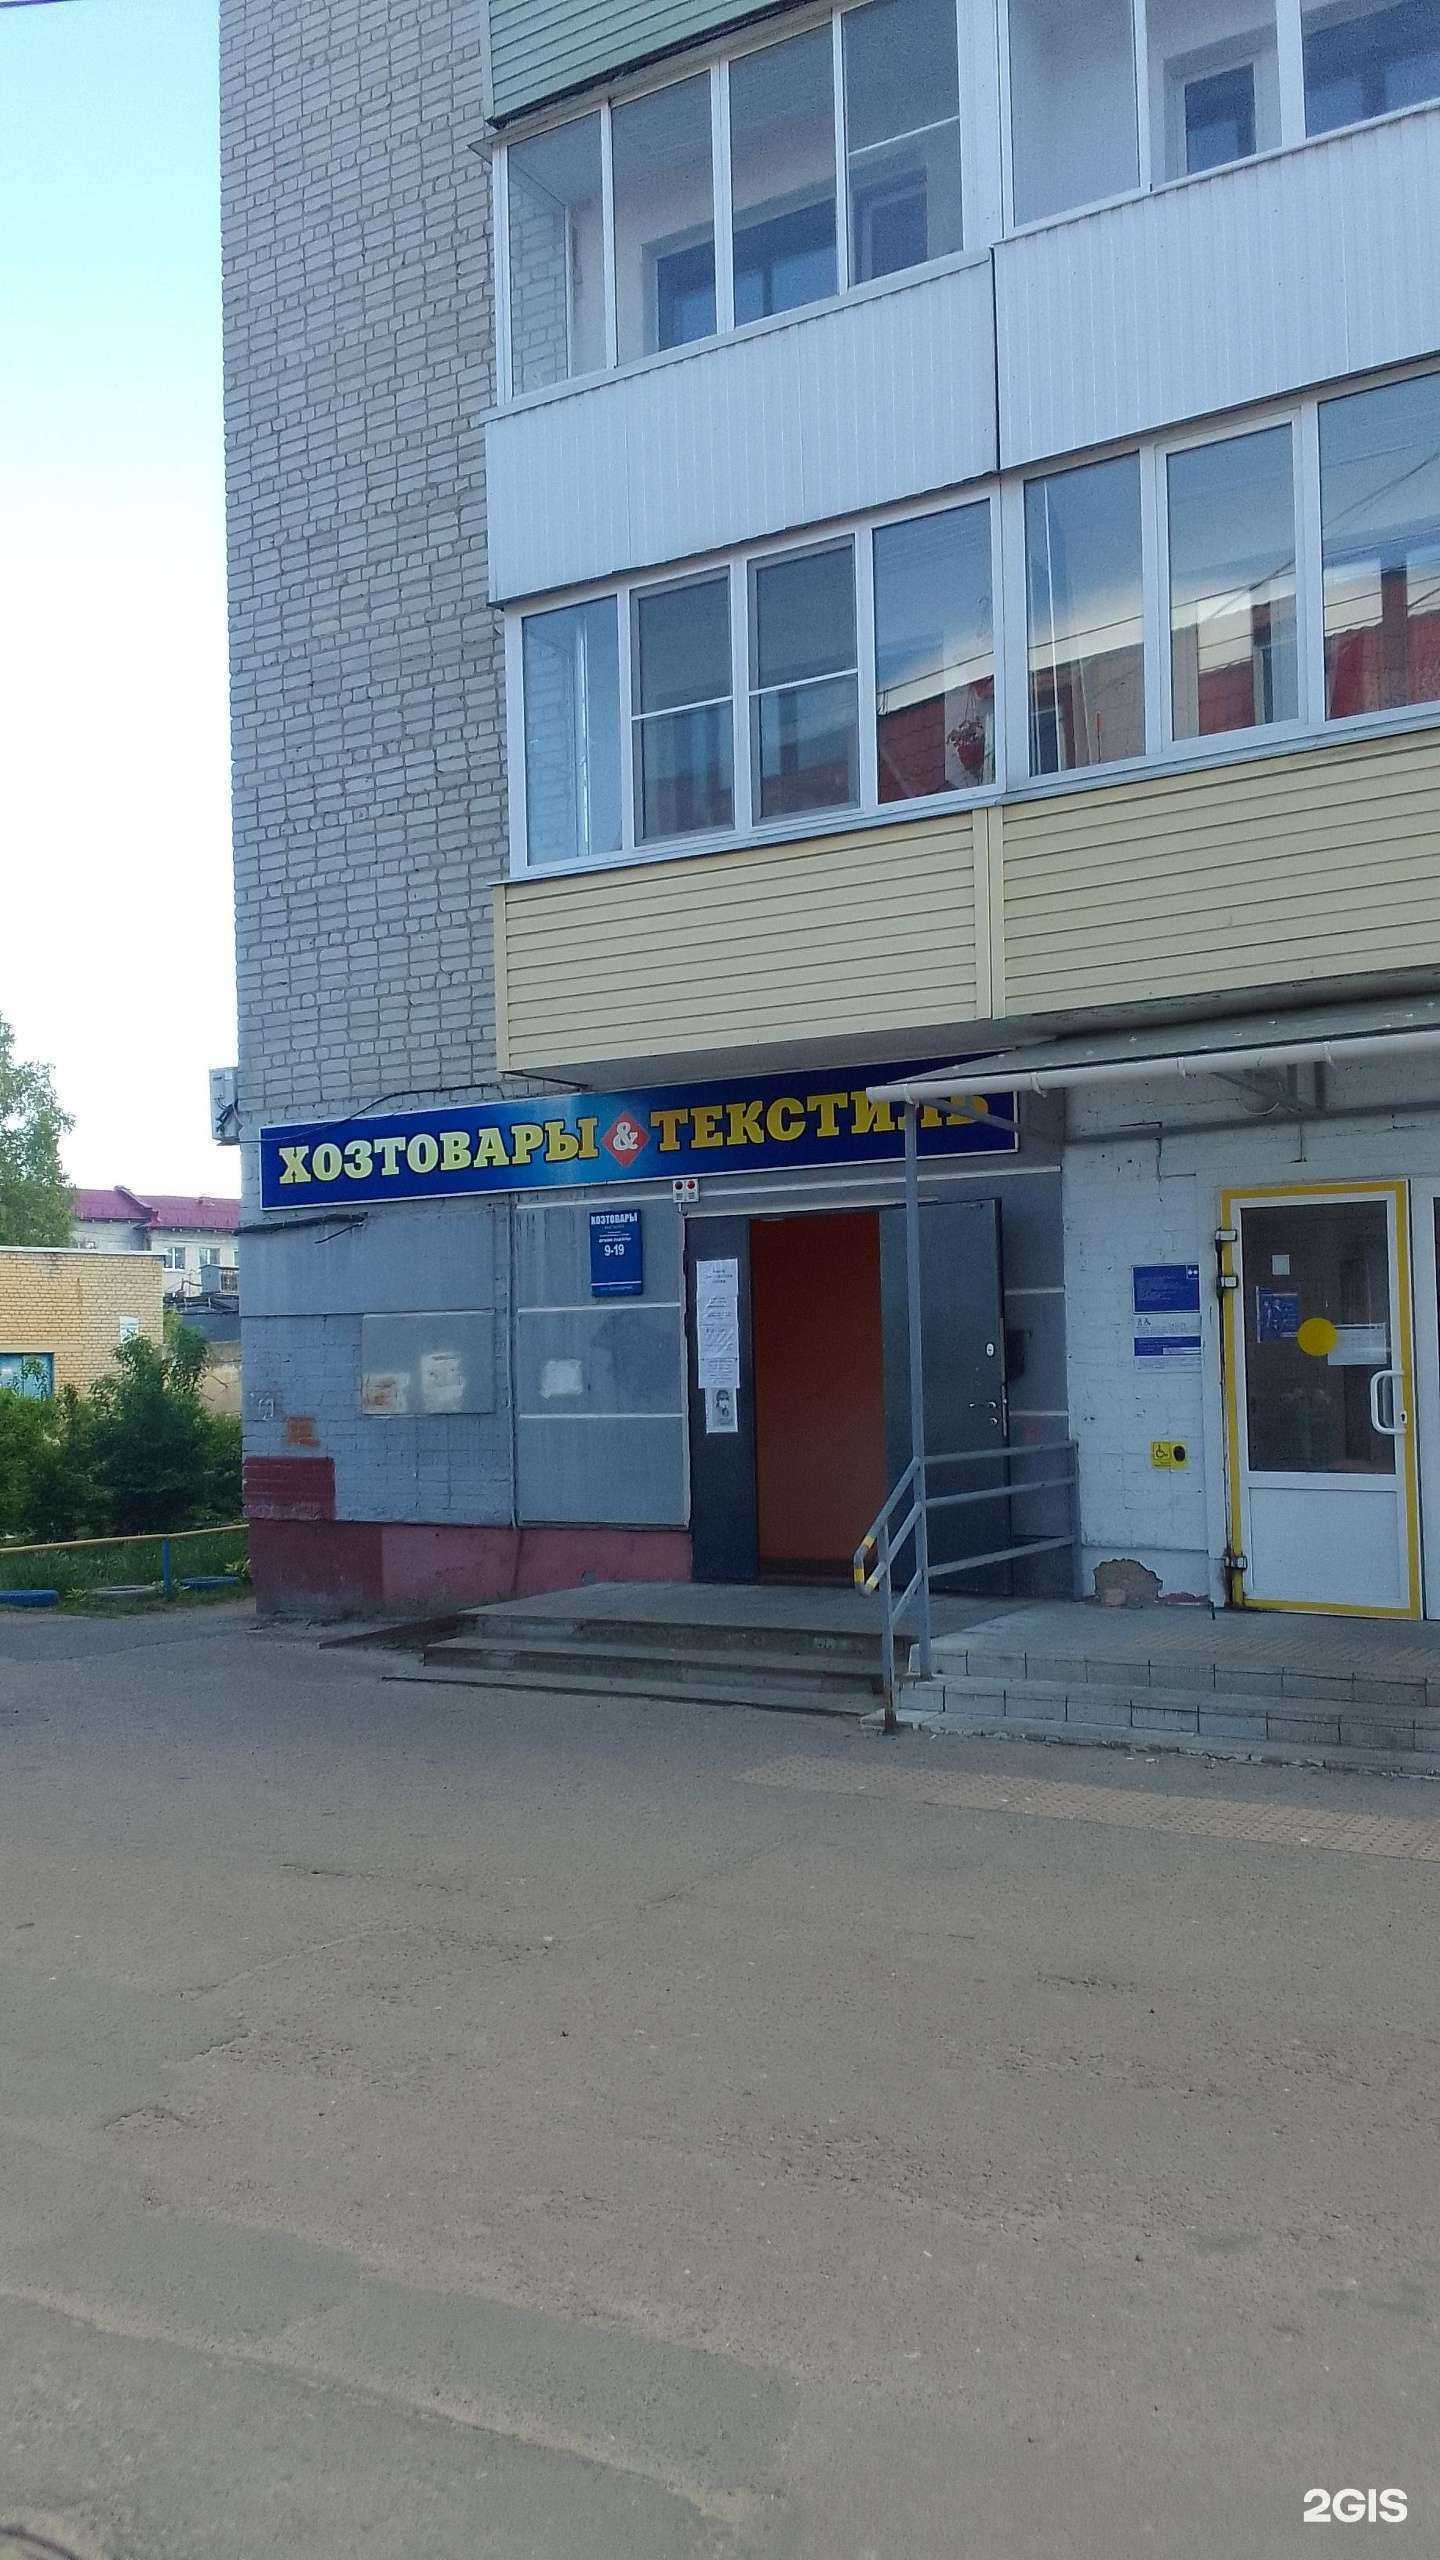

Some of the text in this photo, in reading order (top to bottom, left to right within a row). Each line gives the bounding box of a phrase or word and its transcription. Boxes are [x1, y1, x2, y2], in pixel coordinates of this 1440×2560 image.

[279, 1117, 599, 1184] ХОЗТОВАРЫ
[613, 1121, 639, 1151] &
[604, 1244, 625, 1257] 9-19
